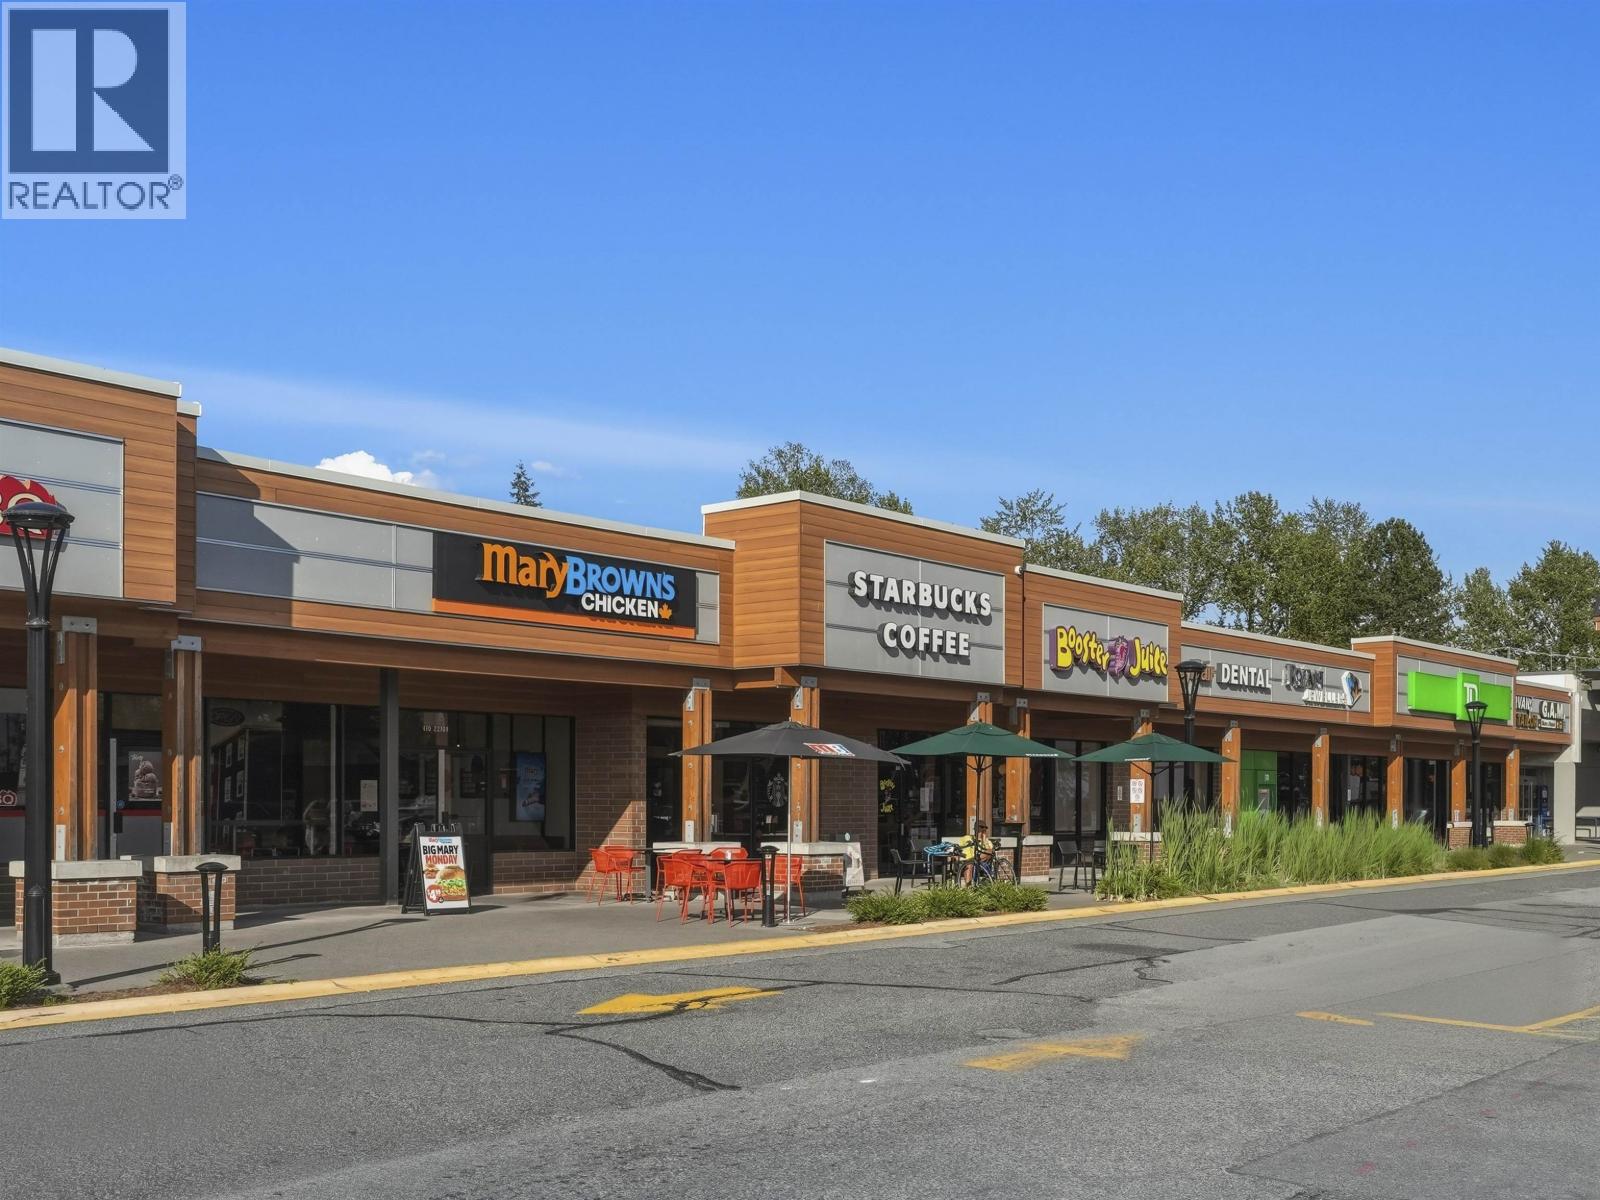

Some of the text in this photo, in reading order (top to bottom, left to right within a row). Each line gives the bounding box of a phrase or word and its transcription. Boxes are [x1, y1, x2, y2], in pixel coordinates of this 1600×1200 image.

[581, 592, 659, 619] CHICKEN
[853, 570, 992, 617] STARBUCKS
[883, 622, 971, 656] COFFEE
[1055, 625, 1168, 677] Booster Juice
[1221, 663, 1273, 689] DENTAL
[422, 845, 459, 856] BIG MARY
[425, 855, 458, 865] MONDAY
